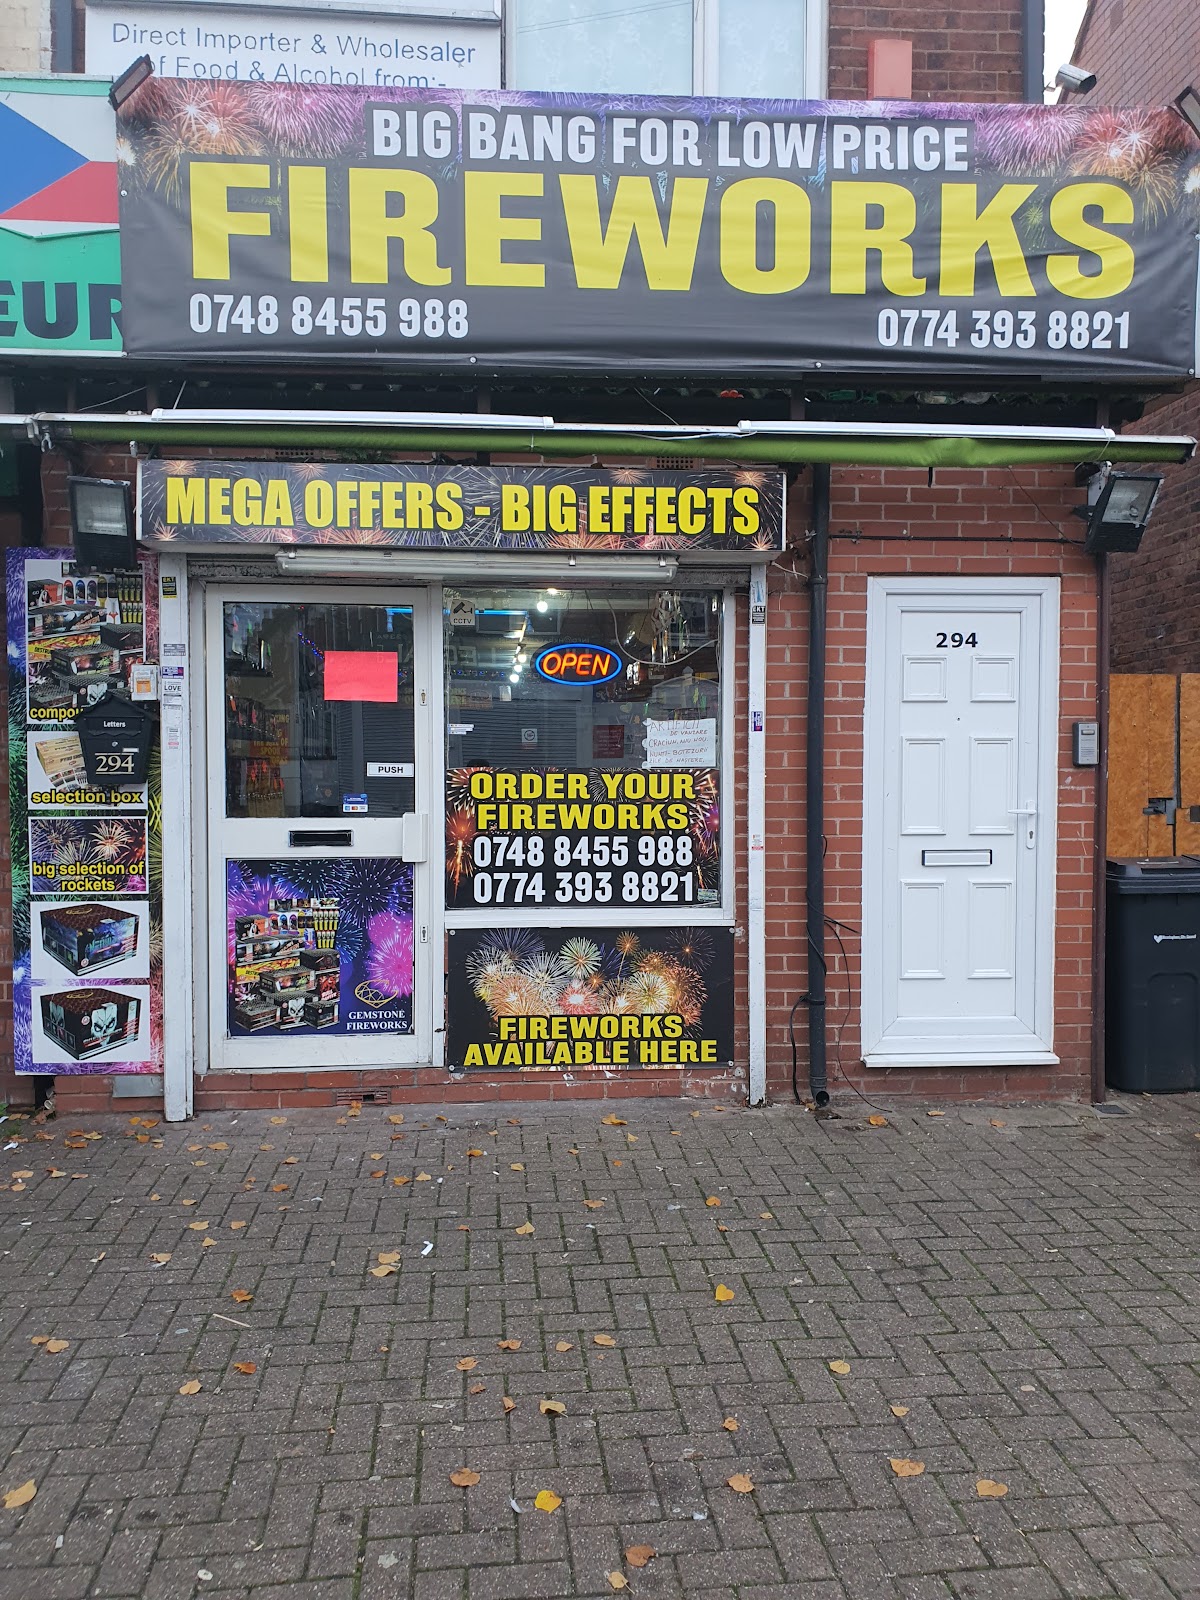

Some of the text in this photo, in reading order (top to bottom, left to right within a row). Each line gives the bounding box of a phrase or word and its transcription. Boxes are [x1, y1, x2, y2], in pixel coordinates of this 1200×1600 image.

[112, 22, 476, 64] Direct Importer & Wholesaler
[176, 56, 238, 80] Food
[249, 61, 265, 81] &
[273, 62, 365, 86] Alcohol
[373, 109, 969, 174] BIG BANG FOR LOW PRICE
[189, 161, 1135, 299] FIREWORKS
[189, 293, 469, 339] 0748 8455 988
[878, 308, 1130, 350] 0774 393 8821
[166, 477, 294, 526] MEGA
[304, 480, 464, 530] OFFERS
[501, 484, 577, 533] BIG
[589, 486, 760, 535] EFFECTS
[936, 632, 978, 648] 294
[542, 652, 612, 676] OPEN
[96, 755, 135, 772] 294
[378, 766, 404, 774] PUSH
[32, 790, 141, 803] selection box
[470, 773, 696, 800] ORDER YOUR
[478, 803, 689, 830] FIREWORKS
[473, 836, 693, 867] 0748 8455 988
[33, 861, 144, 878] big selection of
[61, 878, 115, 891] rockets
[473, 871, 693, 903] 0774 393 8821
[346, 1021, 408, 1031] FIREWORKS
[348, 1011, 406, 1020] GEMSTONE
[500, 1015, 683, 1041] FIREWORKS
[463, 1040, 718, 1066] AVAILABLE HERE
